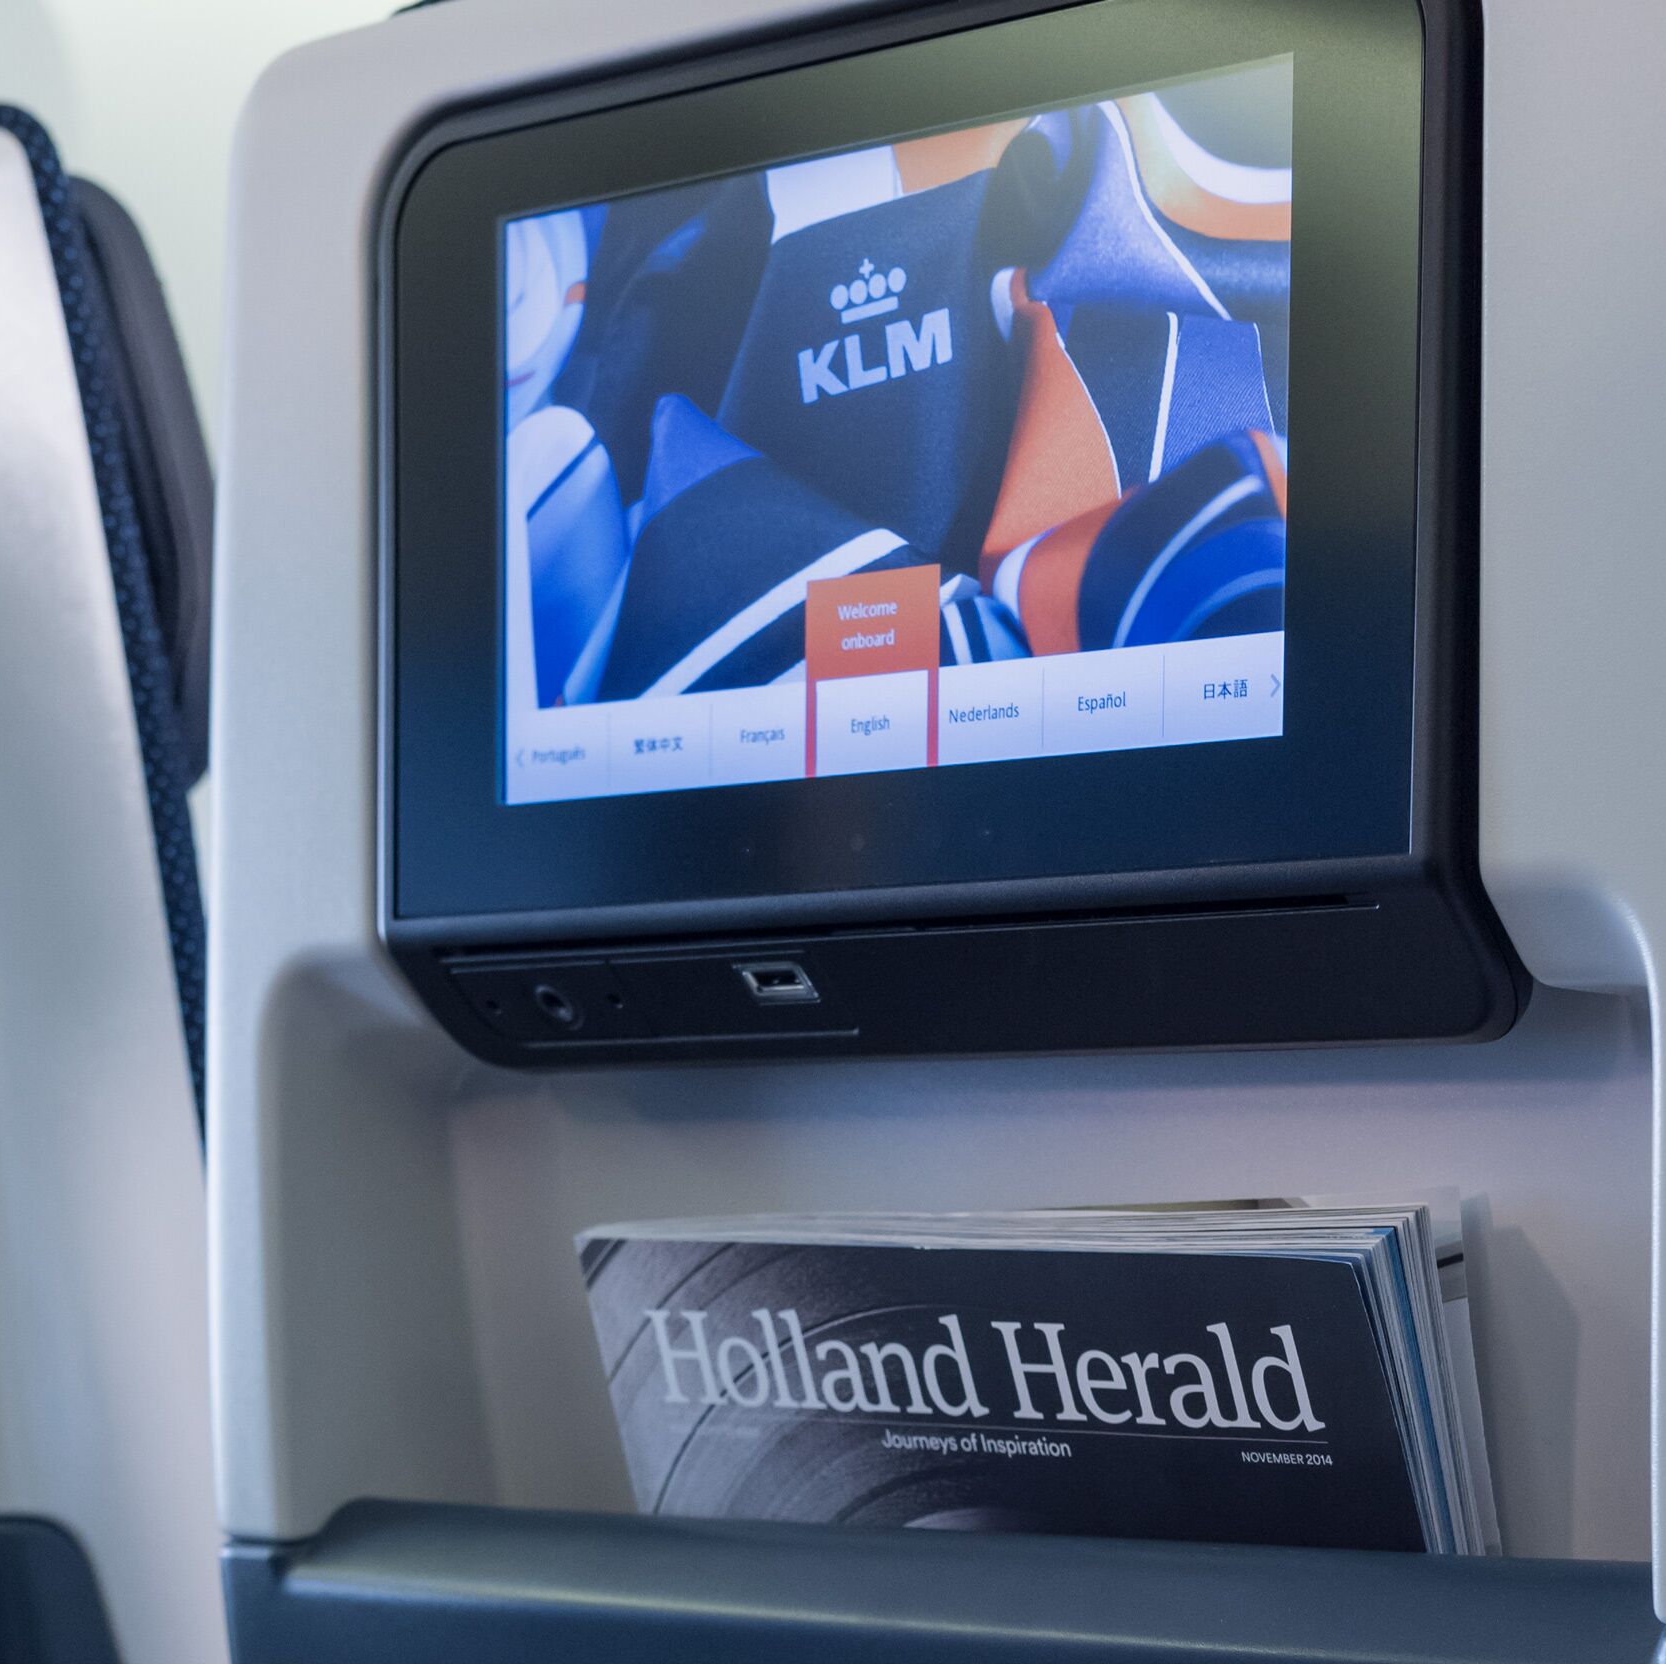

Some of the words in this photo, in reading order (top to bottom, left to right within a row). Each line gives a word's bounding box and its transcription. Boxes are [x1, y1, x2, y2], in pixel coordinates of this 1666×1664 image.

[798, 308, 953, 405] KLM
[837, 601, 898, 622] Welcome
[841, 629, 895, 651] onboard
[1202, 678, 1249, 700] 日本語
[949, 703, 1020, 725] Nederlands
[1077, 691, 1127, 715] Español
[739, 727, 785, 746] Français
[850, 714, 891, 737] English
[642, 1307, 990, 1419] Holland
[989, 1320, 1326, 1432] Herald
[881, 1428, 958, 1456] Journeys
[959, 1432, 978, 1452] of
[980, 1432, 1073, 1459] Inspiration
[1241, 1451, 1305, 1465] NOVEMBER
[1305, 1453, 1333, 1467] 2014
